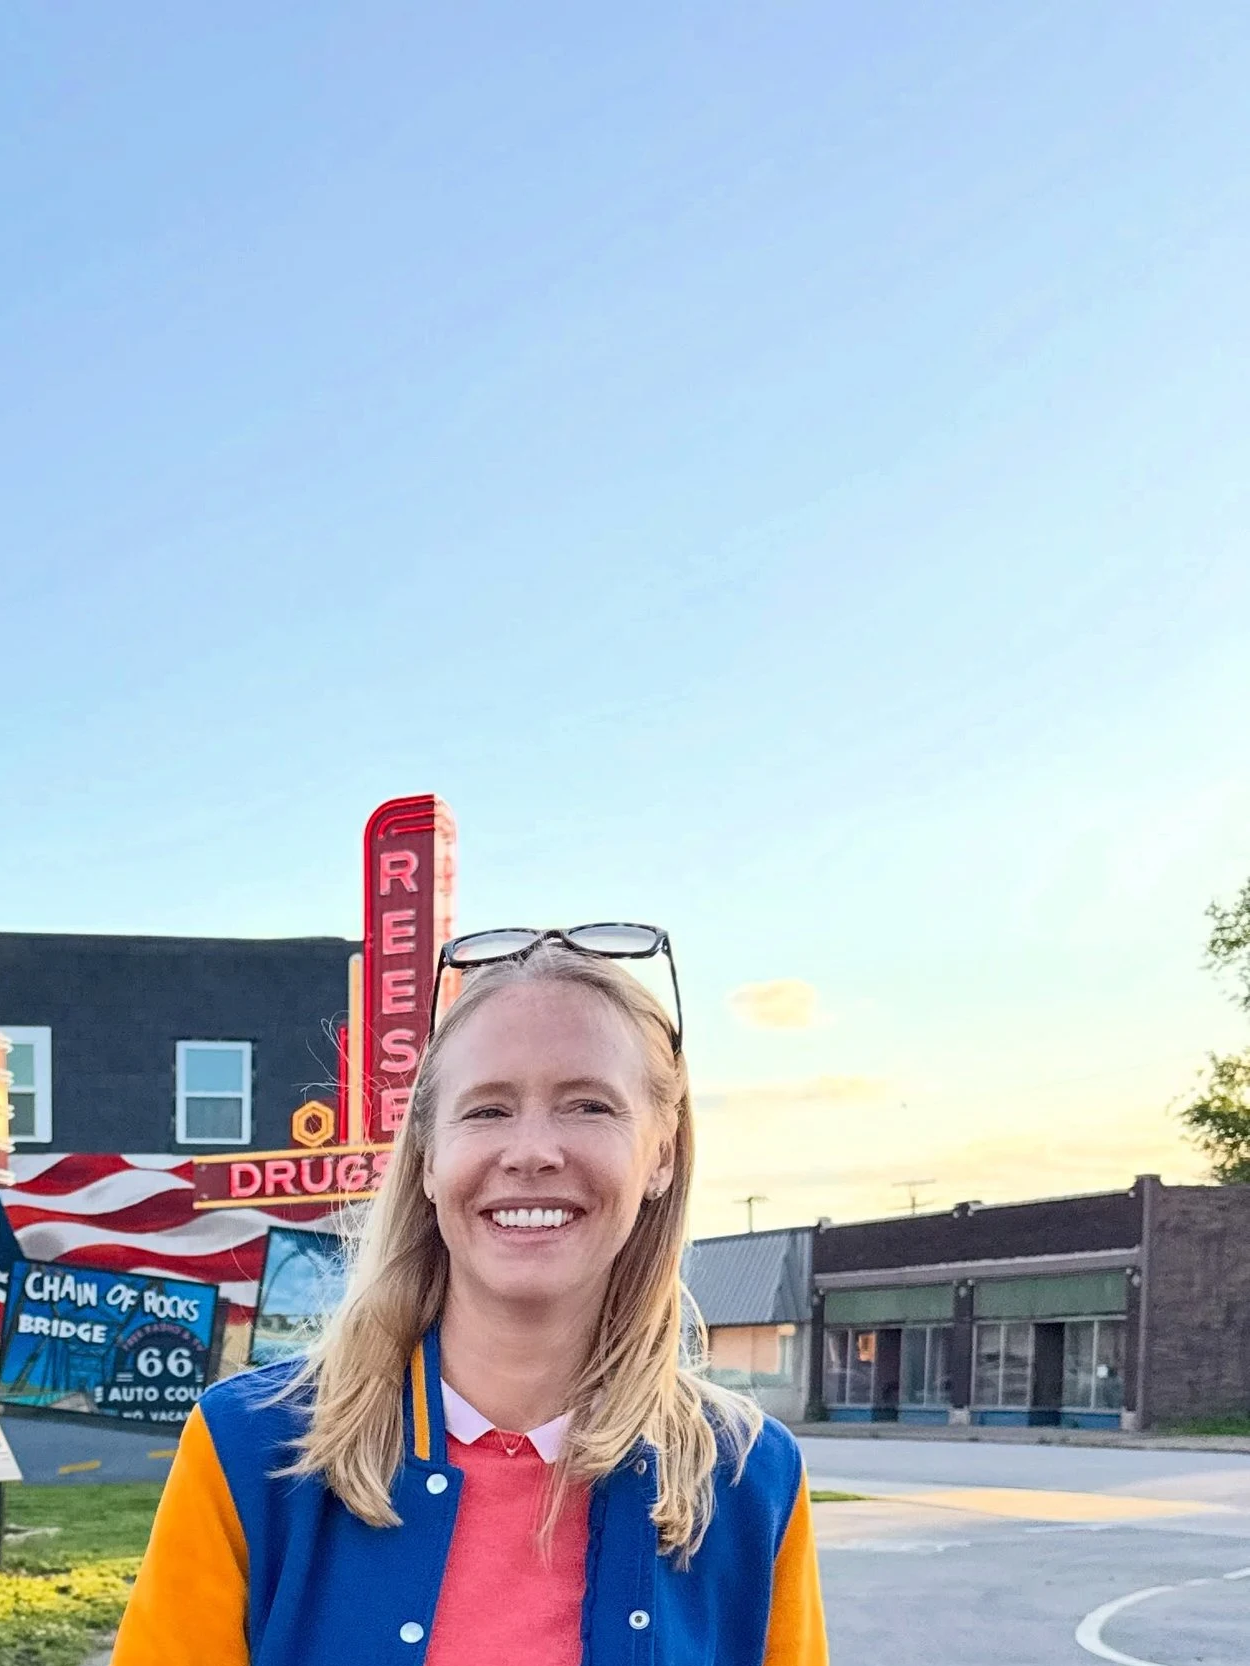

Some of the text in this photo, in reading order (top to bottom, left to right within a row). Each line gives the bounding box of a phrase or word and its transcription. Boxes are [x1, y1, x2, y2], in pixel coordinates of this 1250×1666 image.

[379, 849, 419, 1133] REESE
[24, 1272, 199, 1322] CHAIN OF ROCKS
[18, 1313, 108, 1344] BRIDGE
[137, 1347, 193, 1378] 66
[108, 1386, 203, 1402] AUTO COU
[150, 1410, 190, 1422] VACA
